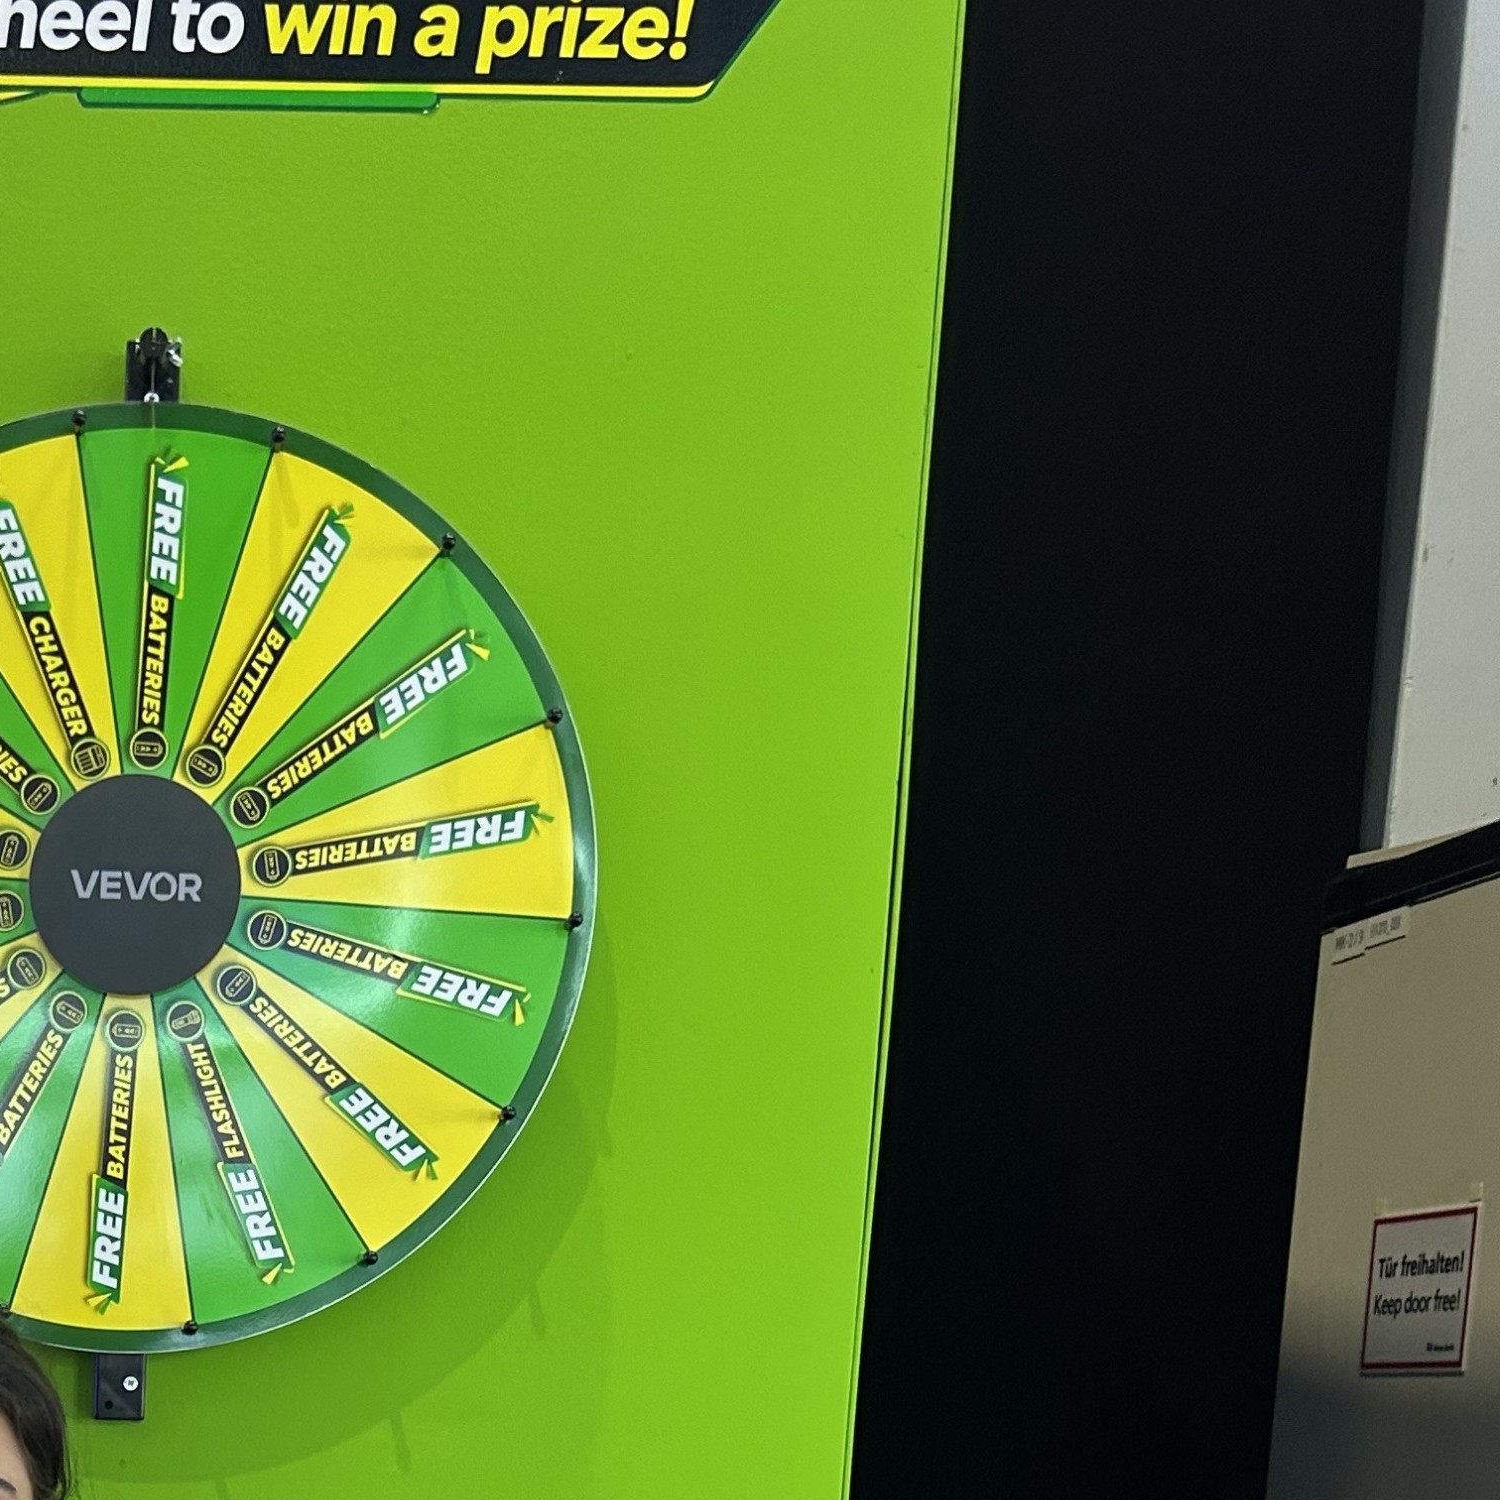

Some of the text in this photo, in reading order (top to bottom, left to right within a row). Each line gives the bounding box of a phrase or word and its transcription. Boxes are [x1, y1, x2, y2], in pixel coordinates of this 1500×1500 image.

[171, 0, 245, 53] to
[265, 0, 396, 55] win
[414, 4, 460, 56] a
[474, 0, 693, 75] prize!
[141, 476, 184, 725] FREE BATTERIES
[211, 525, 347, 749] FREE BATTERIES
[29, 616, 86, 737] CHARGER
[267, 643, 469, 799] FREE BATTERIES
[70, 869, 202, 902] VEVOR
[295, 810, 527, 871] FREE BATTERIES
[287, 929, 513, 1017] FREE BATTERIES
[249, 995, 427, 1167] FREE BATTERIES
[92, 1054, 134, 1290] FREE BATTERIES
[187, 1043, 285, 1262] FREE FLASHLIGHT
[1373, 1288, 1461, 1319] Keep door free!
[1379, 1250, 1465, 1279] Tür freihalten!
